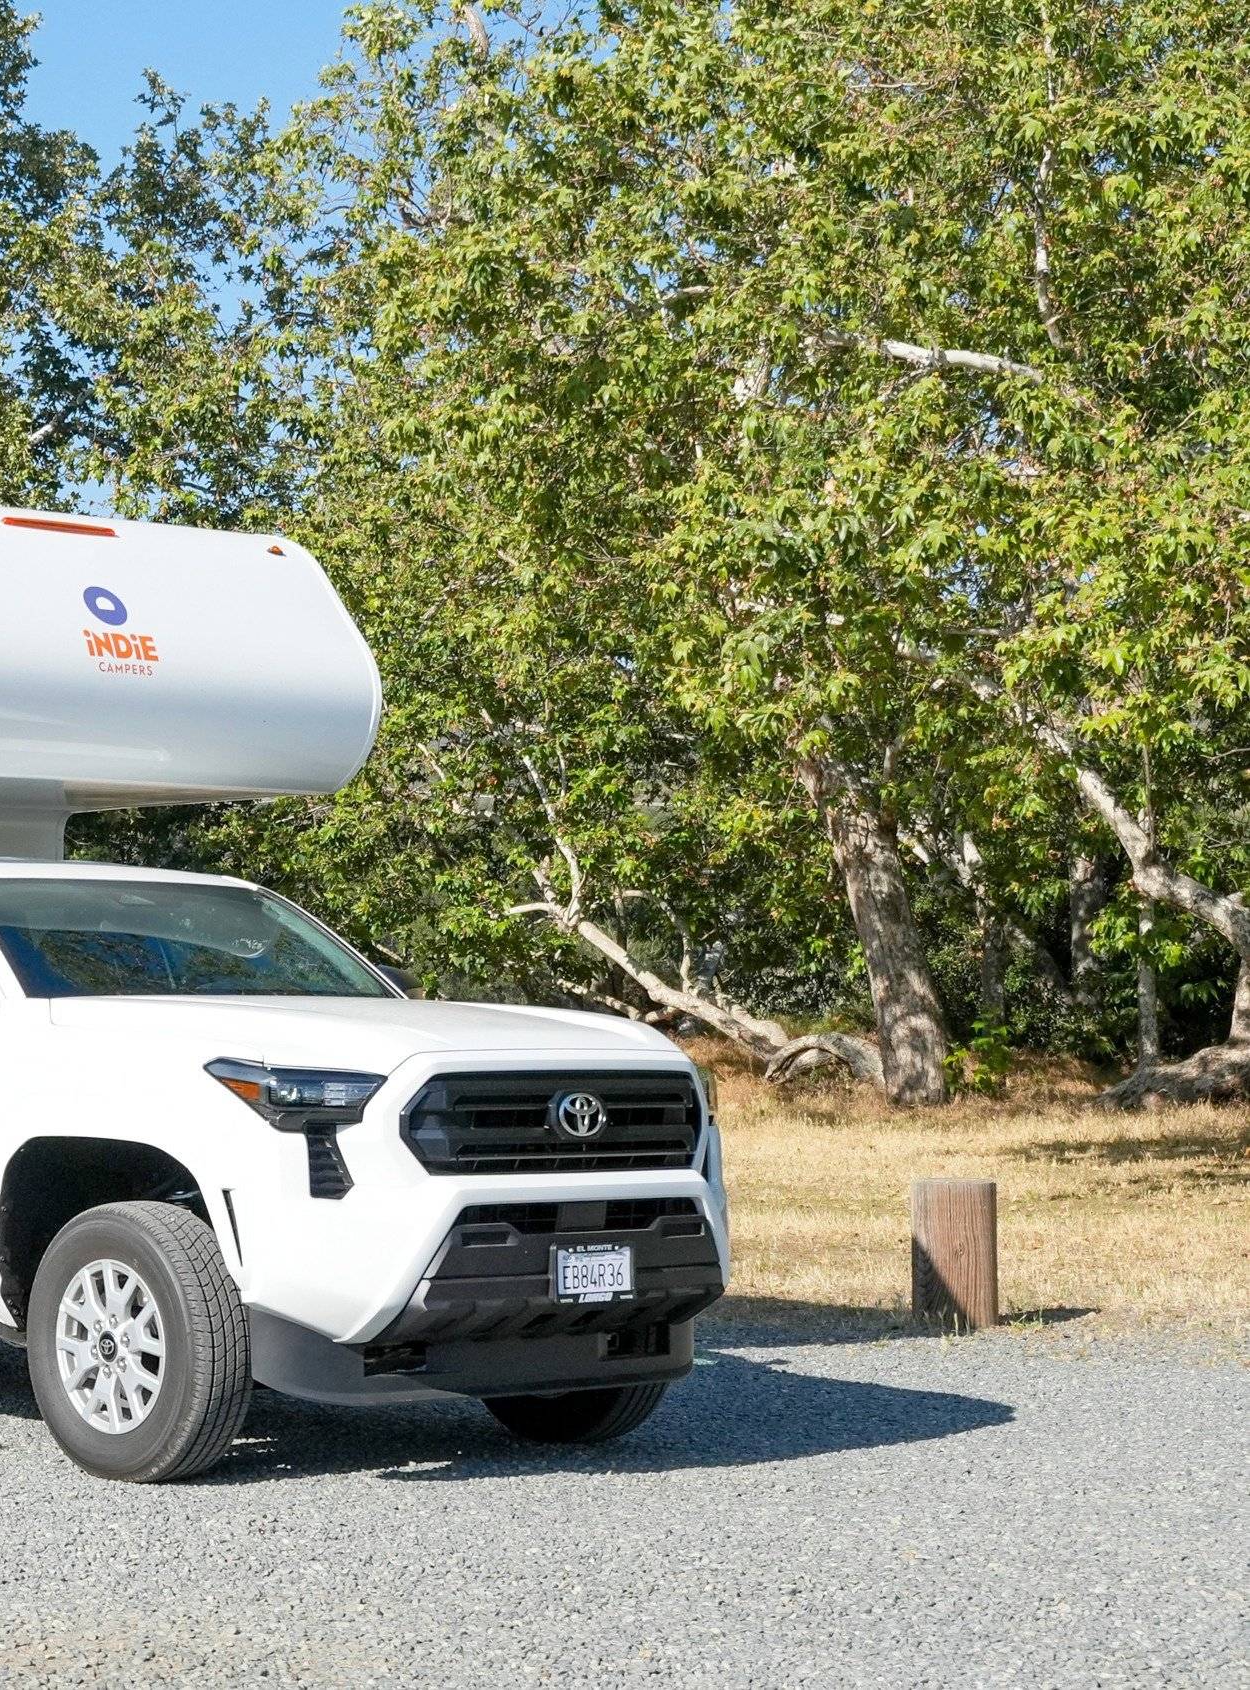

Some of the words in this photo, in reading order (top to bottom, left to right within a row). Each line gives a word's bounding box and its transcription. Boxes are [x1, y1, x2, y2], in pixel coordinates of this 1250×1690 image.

[98, 661, 153, 677] CAMPERS
[587, 1244, 613, 1252] MONTE
[562, 1262, 624, 1290] EB84R36
